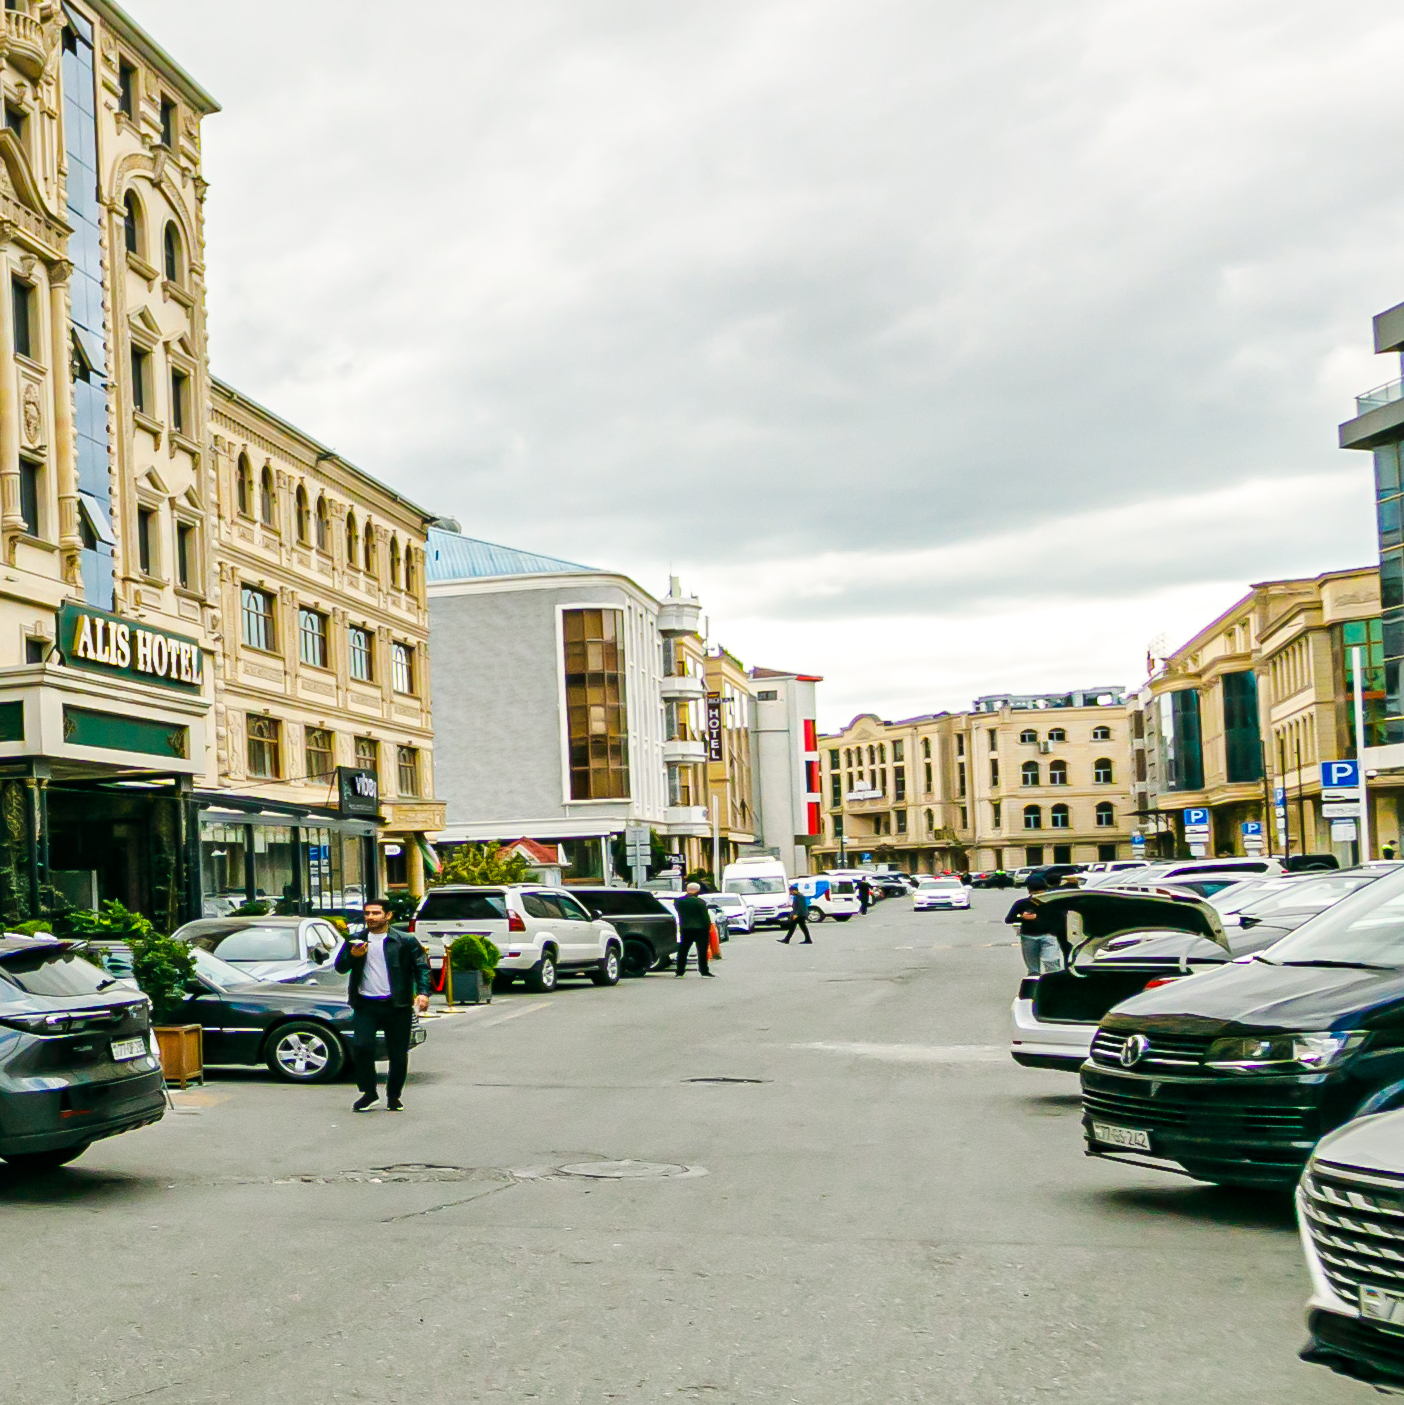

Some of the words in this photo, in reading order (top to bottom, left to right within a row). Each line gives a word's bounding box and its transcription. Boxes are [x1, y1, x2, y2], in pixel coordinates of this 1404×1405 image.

[77, 614, 131, 669] ALIS
[136, 629, 203, 686] HOTEL
[708, 708, 720, 759] HOTEL
[1331, 763, 1353, 784] P
[1191, 810, 1204, 823] P
[1247, 823, 1258, 833] P
